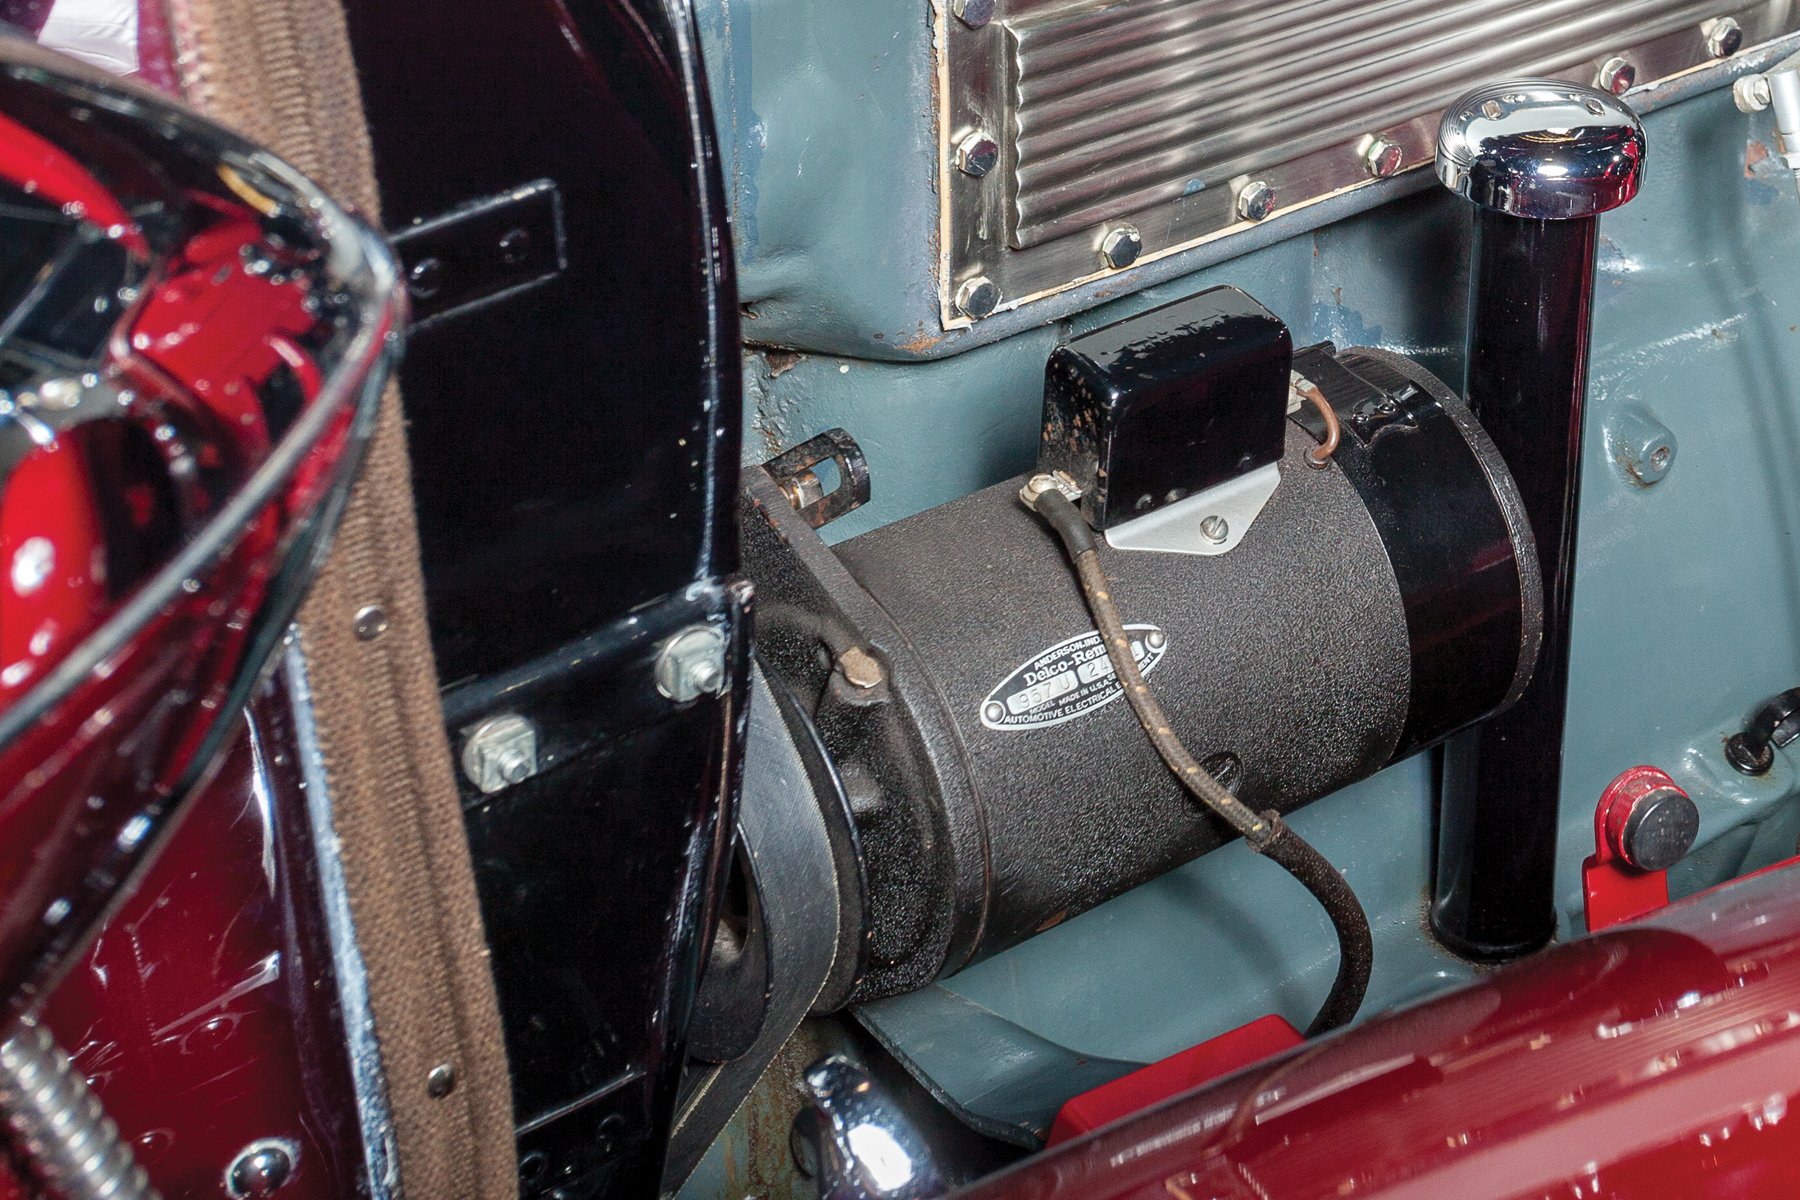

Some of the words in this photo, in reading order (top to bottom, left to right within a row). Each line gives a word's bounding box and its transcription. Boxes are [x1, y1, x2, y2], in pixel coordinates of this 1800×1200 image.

[1023, 644, 1108, 686] Delco-Rem
[1004, 708, 1063, 724] AUTOMOTIVE
[1065, 688, 1115, 714] ELECTRICAL
[1030, 700, 1056, 715] MODEL
[1058, 691, 1080, 706] MADE
[1080, 687, 1089, 698] IN
